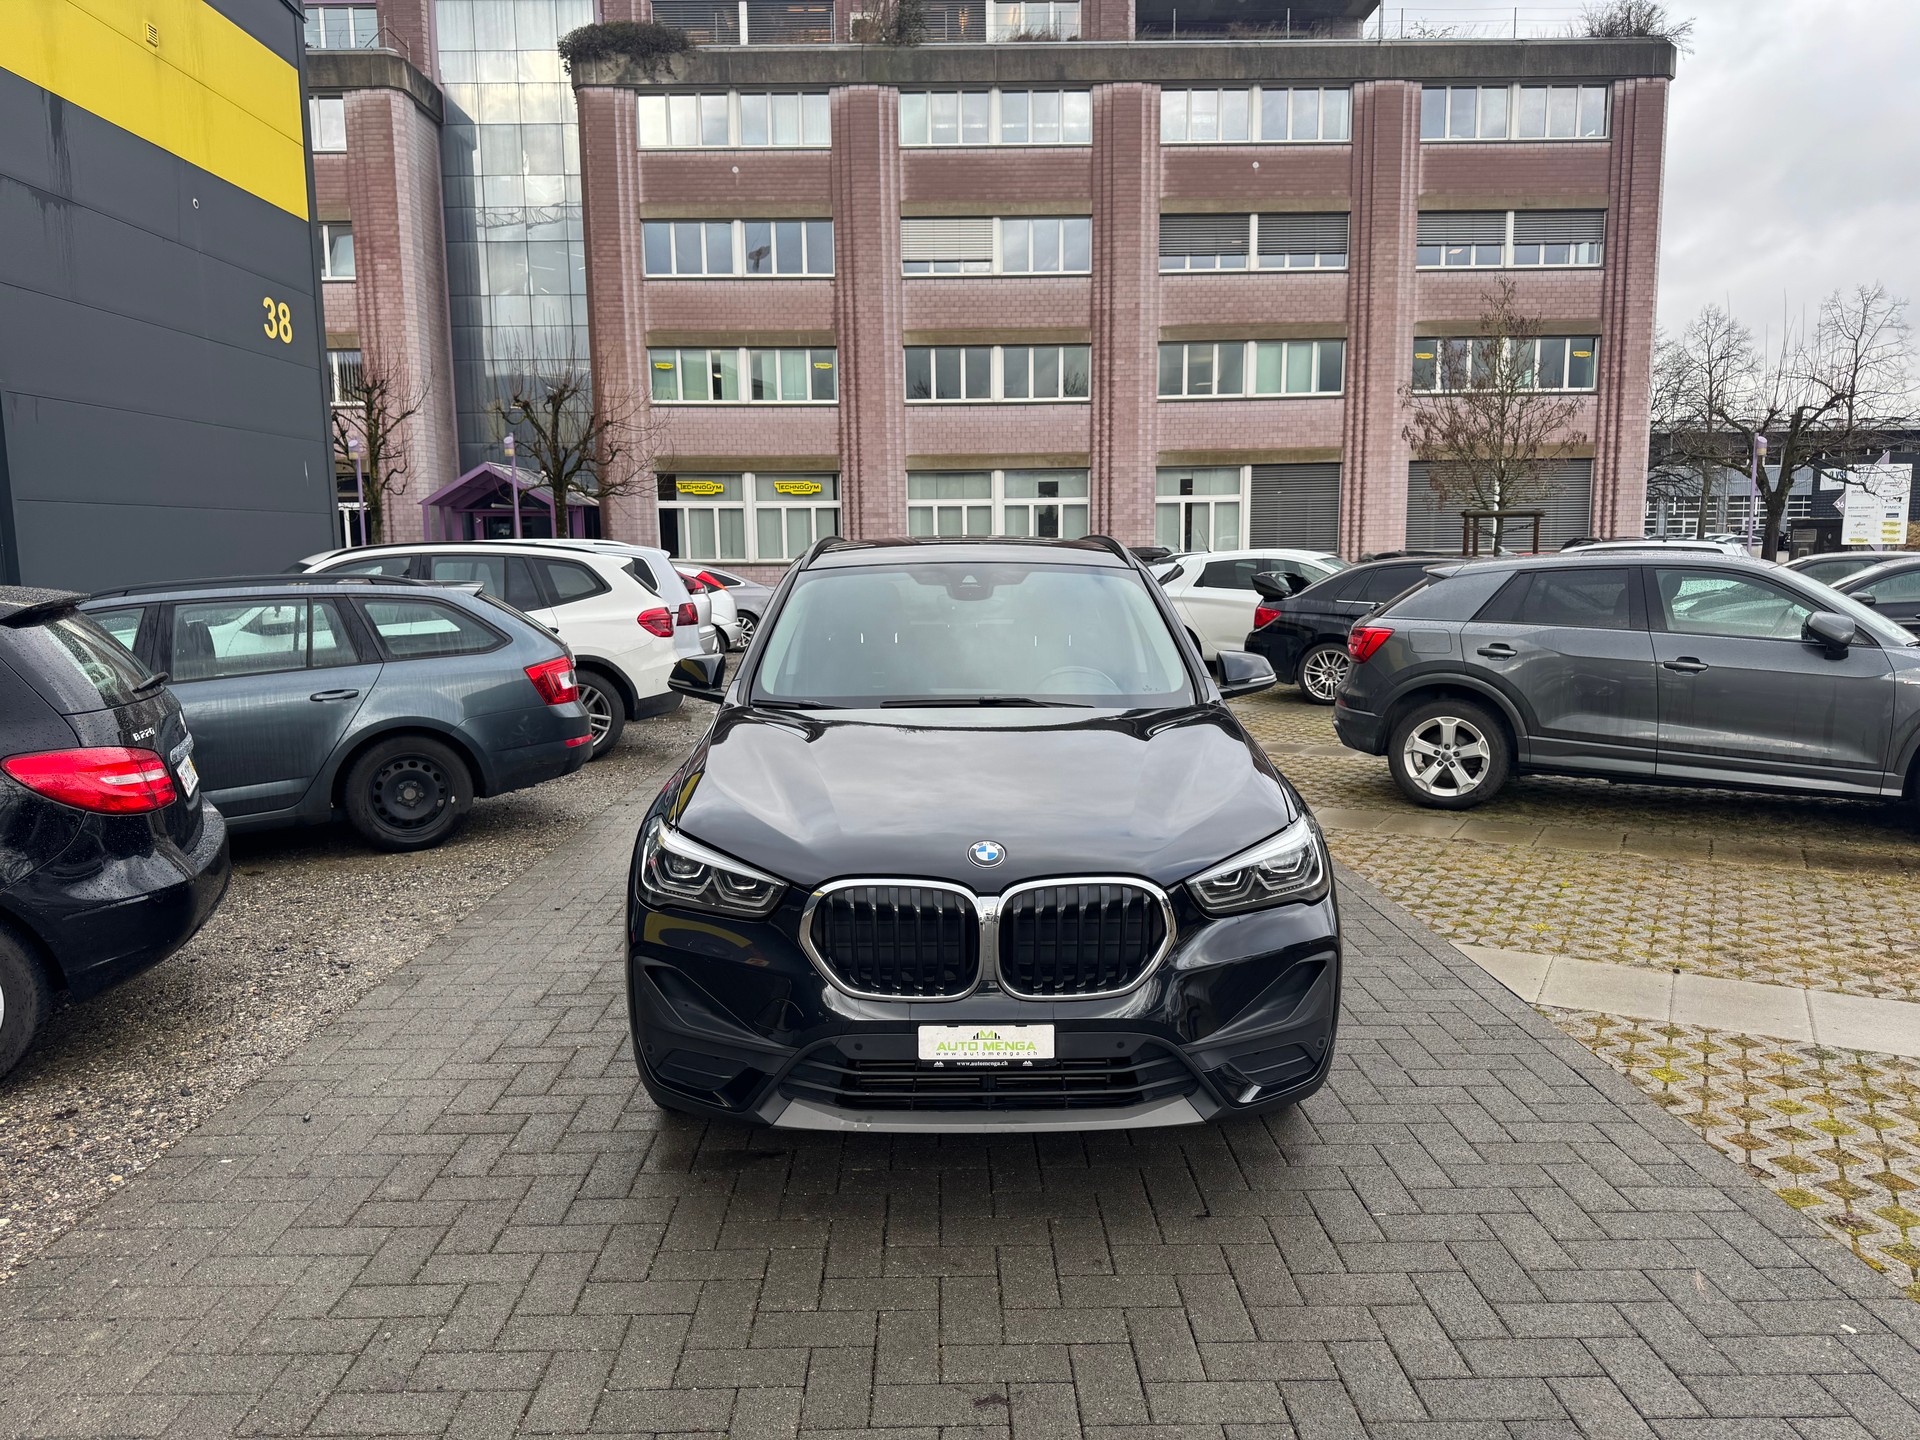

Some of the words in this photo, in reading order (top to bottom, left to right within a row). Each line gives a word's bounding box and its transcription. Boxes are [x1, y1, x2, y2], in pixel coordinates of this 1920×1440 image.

[262, 296, 293, 344] 38
[132, 727, 155, 742] B220
[936, 1041, 978, 1051] AUTO
[983, 1041, 1036, 1051] MENGA
